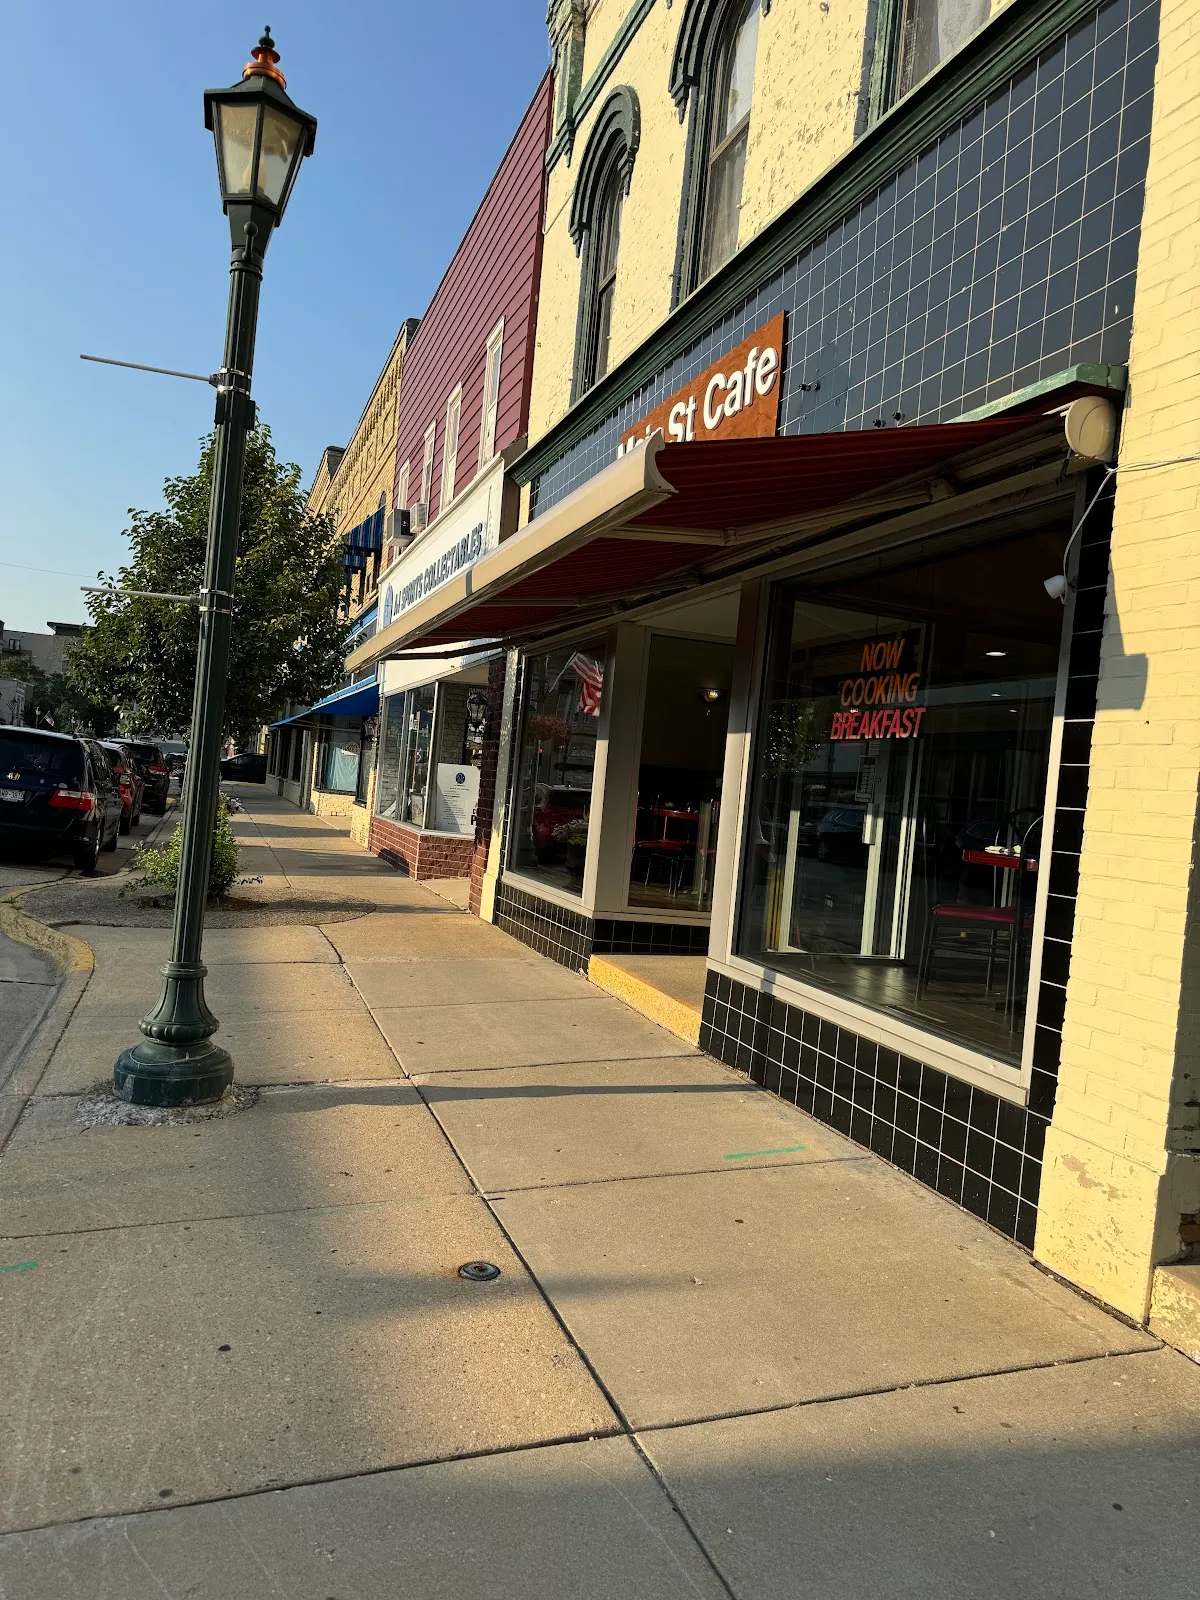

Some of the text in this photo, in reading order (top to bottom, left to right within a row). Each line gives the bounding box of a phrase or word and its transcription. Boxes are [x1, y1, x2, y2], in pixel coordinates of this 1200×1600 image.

[668, 395, 696, 443] St
[703, 346, 778, 430] Cafe
[401, 573, 423, 611] SPORTS
[424, 522, 483, 595] COLLECTABLES
[860, 639, 906, 672] NOW
[840, 672, 921, 706] COOKING
[830, 707, 927, 740] BREAKFAST
